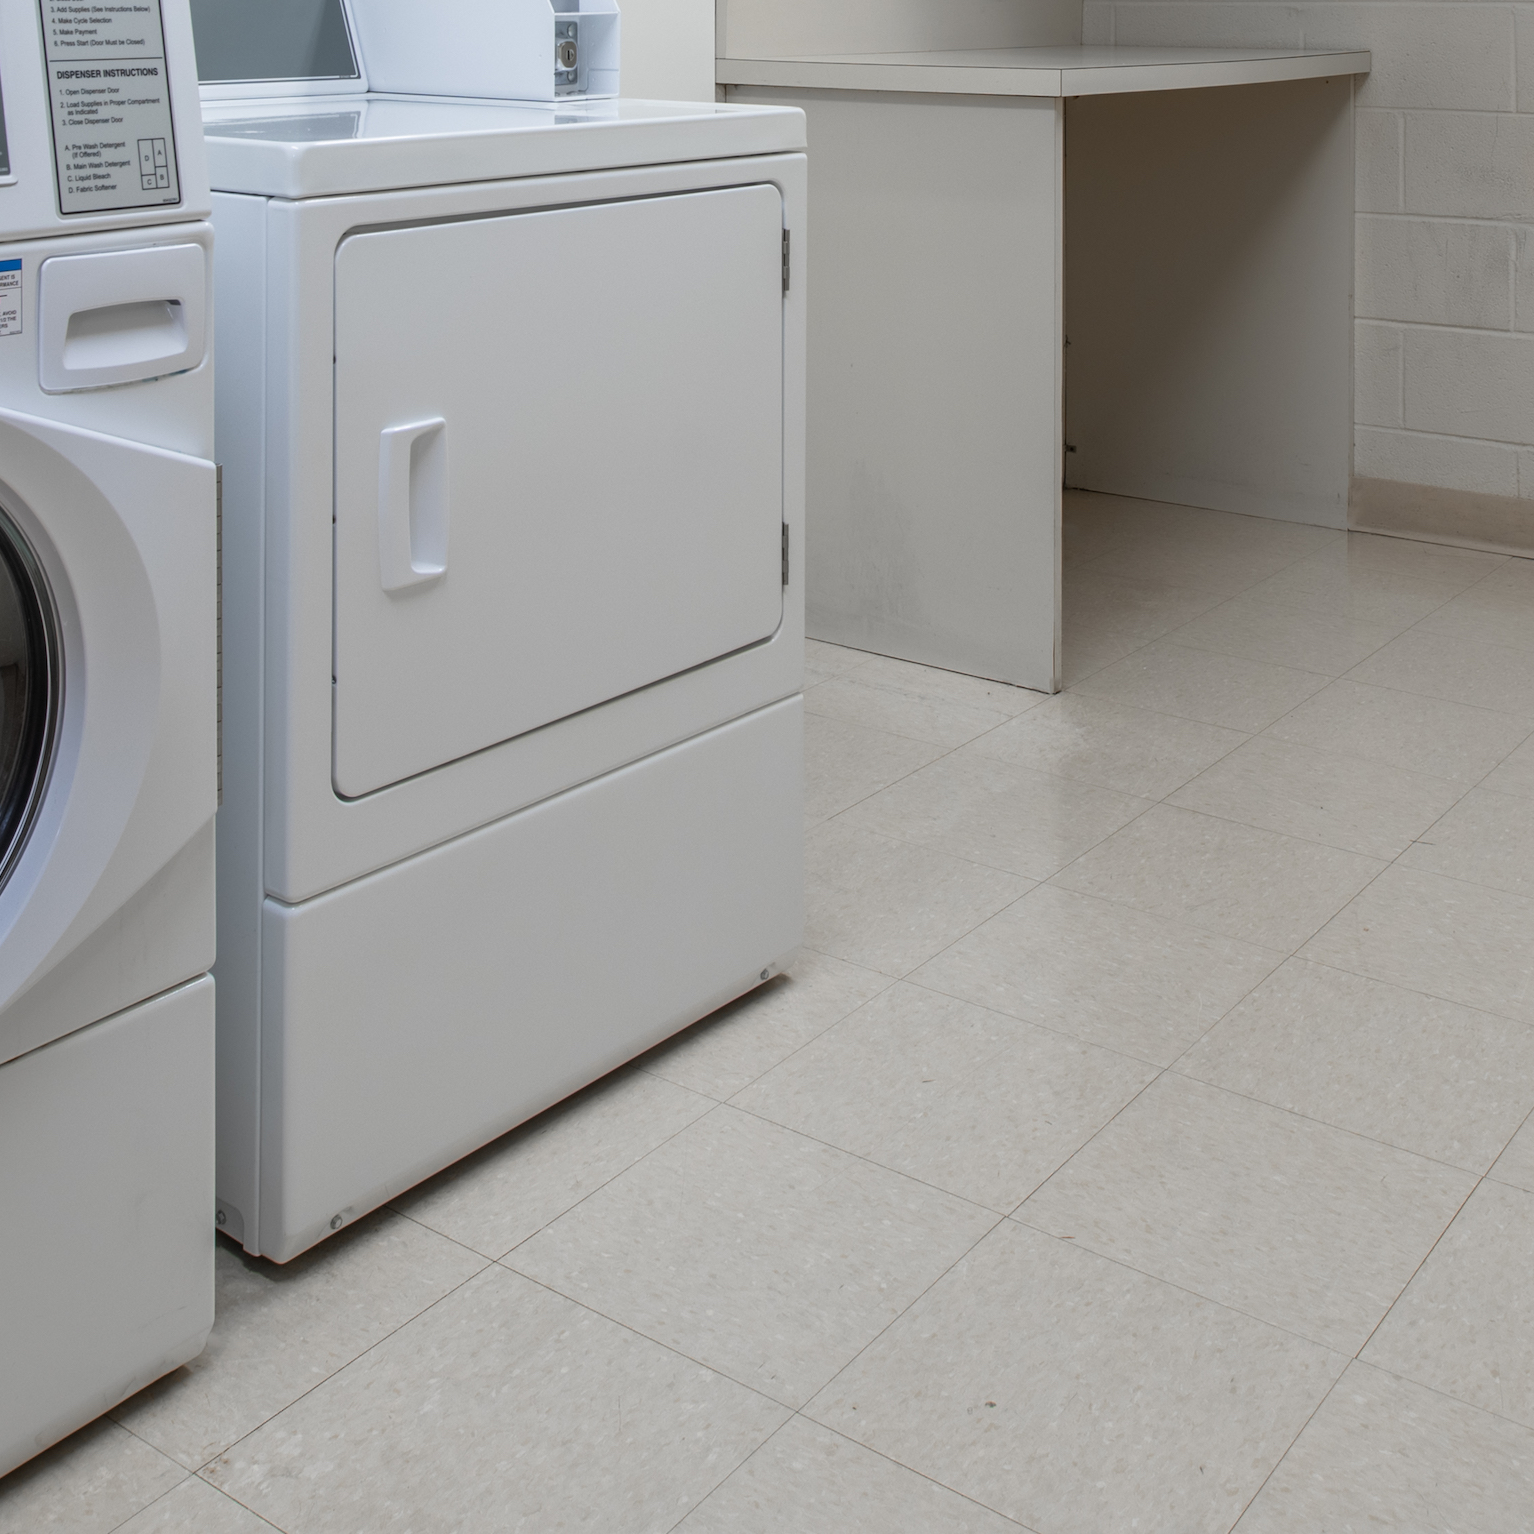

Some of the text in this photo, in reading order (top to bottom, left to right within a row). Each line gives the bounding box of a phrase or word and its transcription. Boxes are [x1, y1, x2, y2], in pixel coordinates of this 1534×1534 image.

[74, 28, 97, 36] Payment
[56, 67, 158, 79] DISPENSER INSTRUCTIONS
